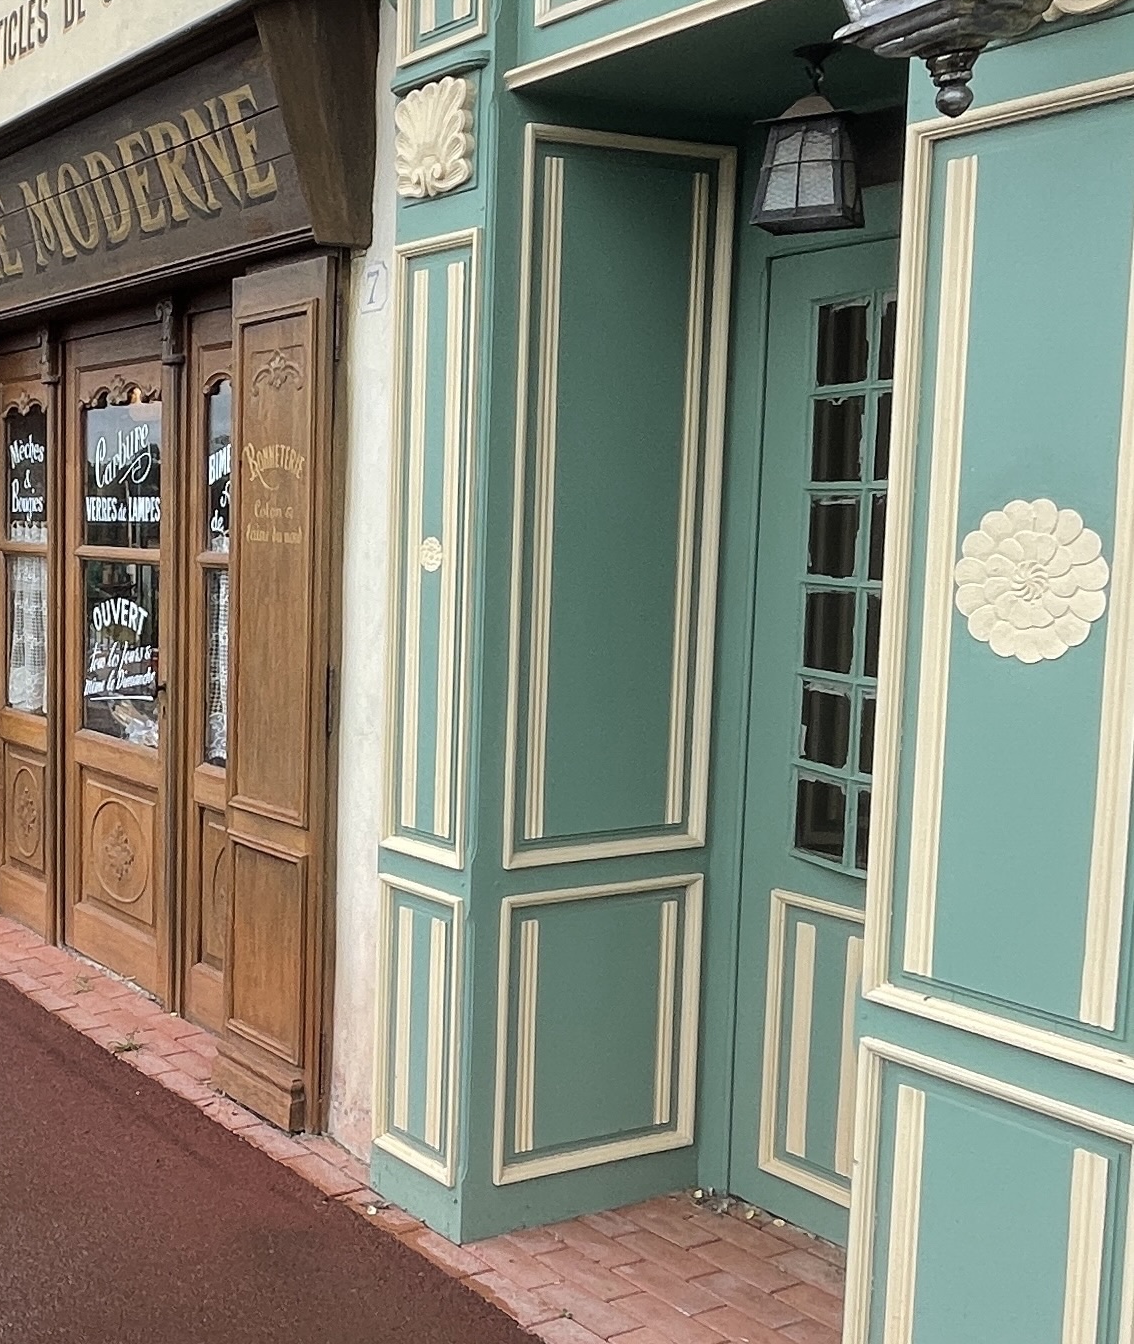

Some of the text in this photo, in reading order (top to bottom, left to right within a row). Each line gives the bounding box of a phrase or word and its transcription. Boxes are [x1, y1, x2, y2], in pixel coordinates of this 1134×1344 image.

[18, 84, 278, 268] MODERNE
[366, 269, 380, 306] 7
[9, 433, 45, 470] Mèches
[95, 423, 152, 489] Carbure
[85, 496, 118, 522] VERRES
[128, 496, 161, 522] LAMPES
[93, 597, 149, 636] OUVERT
